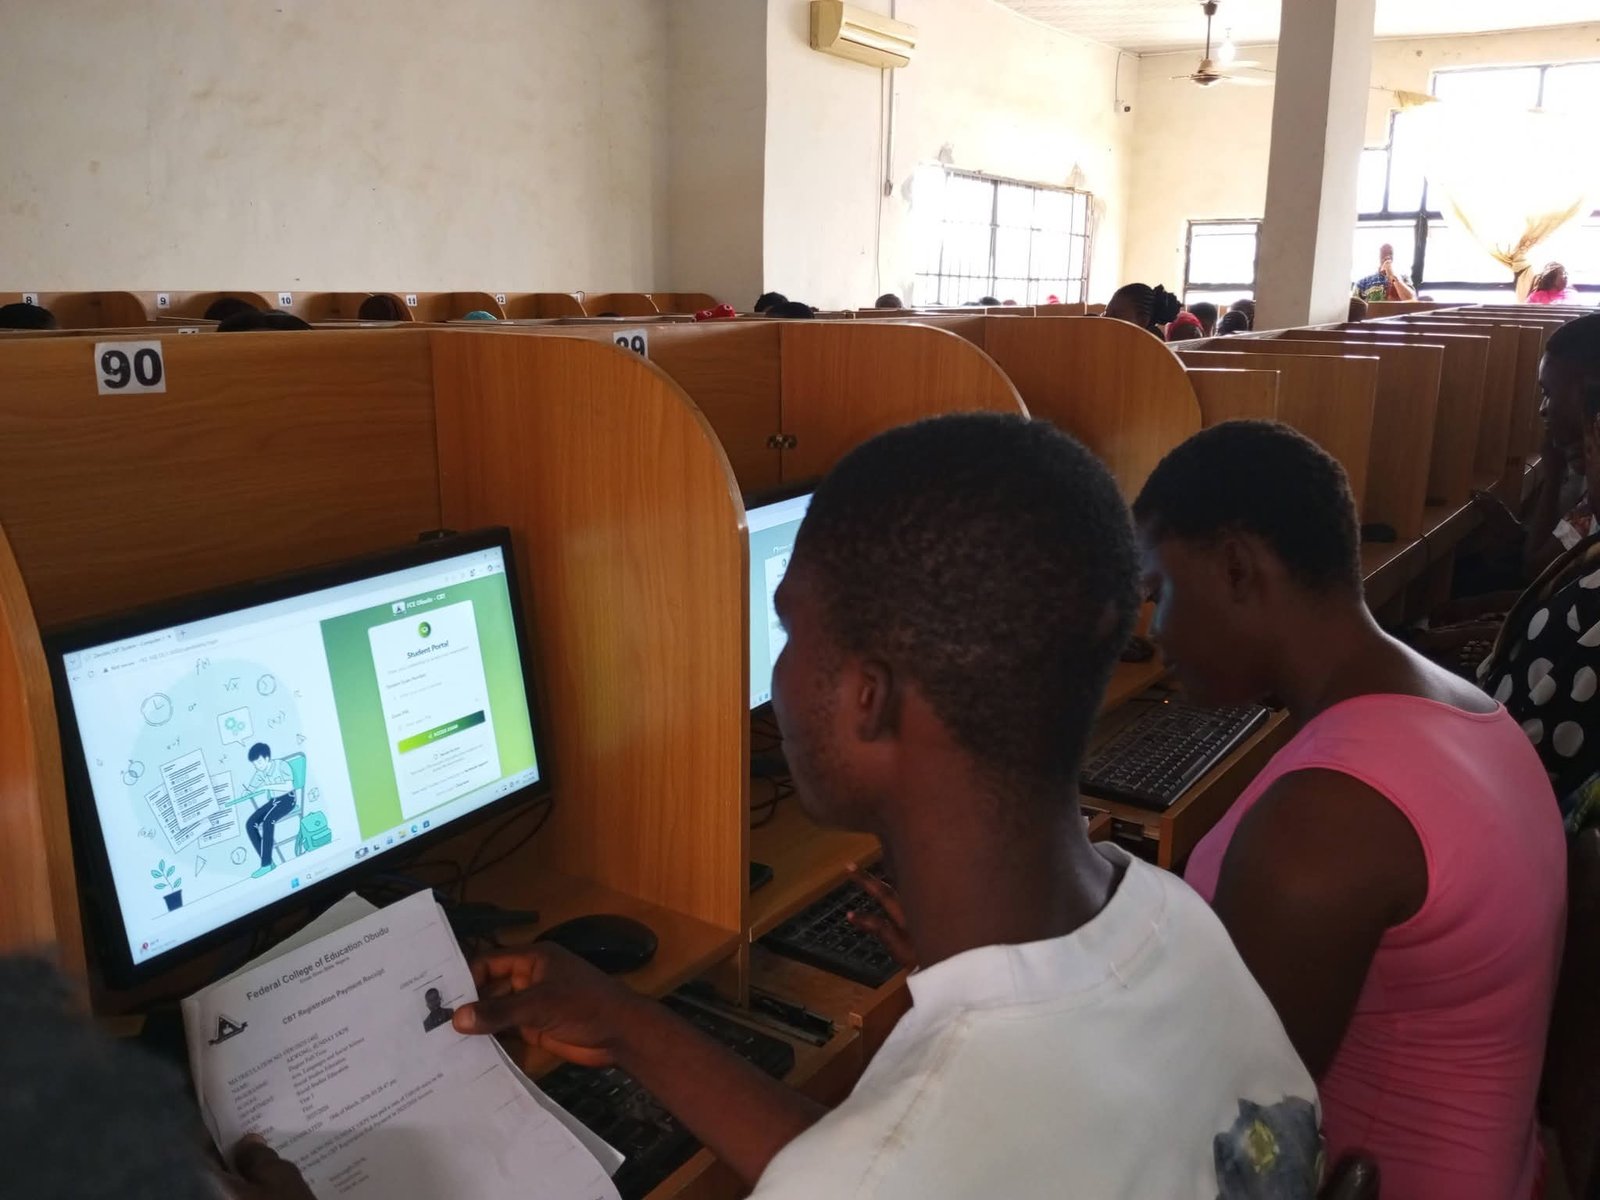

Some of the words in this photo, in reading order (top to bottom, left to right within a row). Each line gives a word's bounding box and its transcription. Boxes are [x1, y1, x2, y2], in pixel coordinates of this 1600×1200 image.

[25, 296, 33, 305] 8
[159, 297, 166, 305] 9
[101, 348, 162, 389] 90
[407, 646, 431, 659] Student
[431, 640, 448, 651] Portal
[246, 980, 281, 1001] Federal
[282, 965, 313, 985] College
[314, 957, 324, 969] of
[323, 940, 362, 963] Education
[363, 927, 389, 944] Obudu
[282, 1013, 297, 1025] CBT
[298, 993, 336, 1017] Registration
[336, 978, 362, 997] Payment
[363, 967, 386, 983] Receipt
